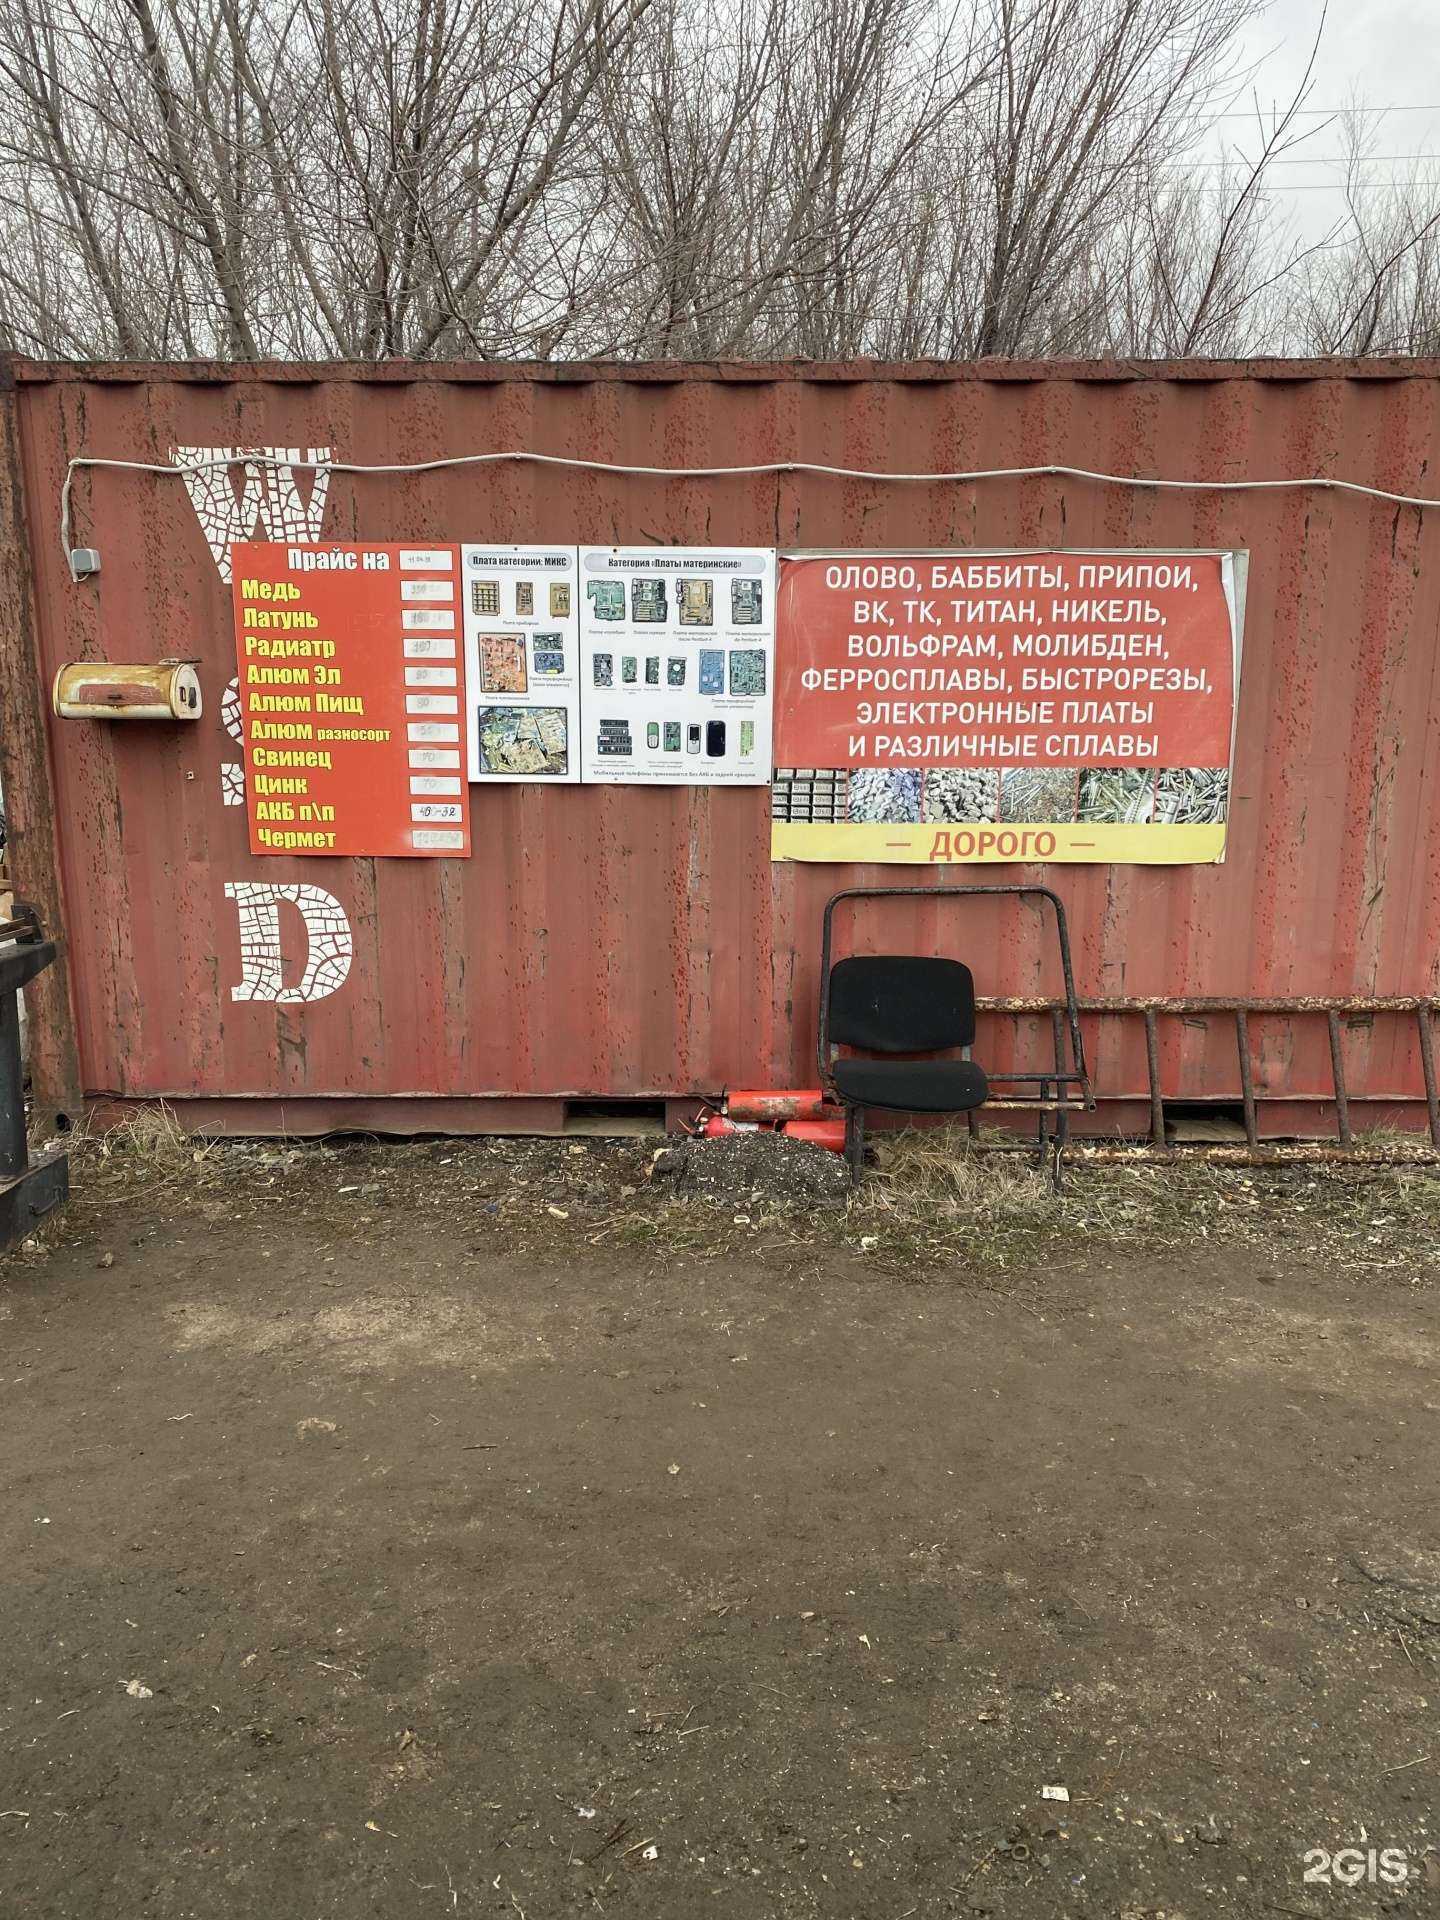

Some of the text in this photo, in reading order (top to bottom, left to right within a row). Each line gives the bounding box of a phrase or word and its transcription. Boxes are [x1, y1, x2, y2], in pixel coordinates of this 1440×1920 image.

[287, 547, 358, 572] Прайс
[362, 551, 390, 570] на
[473, 556, 567, 567] Плата категории: МИКС
[608, 558, 650, 568] Категория
[825, 565, 1199, 592] ОЛОВО, БАББИТЫ, ПРИПОИ,
[241, 579, 301, 602] Медь
[243, 608, 319, 630] Латунь
[853, 600, 1168, 627] ВК, ТК, ТИТАН, НИКЕЛЬ,
[244, 636, 336, 659] Радиатр
[847, 634, 1170, 661] ВОЛЬФРАМ, МОЛИБДЕН,
[246, 664, 341, 685] Алюм Эл
[801, 668, 1213, 695] ФЕРРОСПЛАВЫ, БЫСТРОРЕЗЫ,
[249, 693, 364, 715] Алюм Пищ
[856, 701, 1153, 724] ЭЛЕКТРОННЫЕ ПЛАТЫ
[250, 720, 391, 742] Алюм разносорт
[849, 735, 1159, 757] И РАЗЛИЧНЫЕ СПЛАВЫ
[252, 747, 332, 770] Свинец
[254, 775, 308, 796] Цинк
[256, 801, 336, 821] АКБ п\п
[258, 828, 337, 848] Чермет
[929, 831, 1057, 862] ДОРОГО
